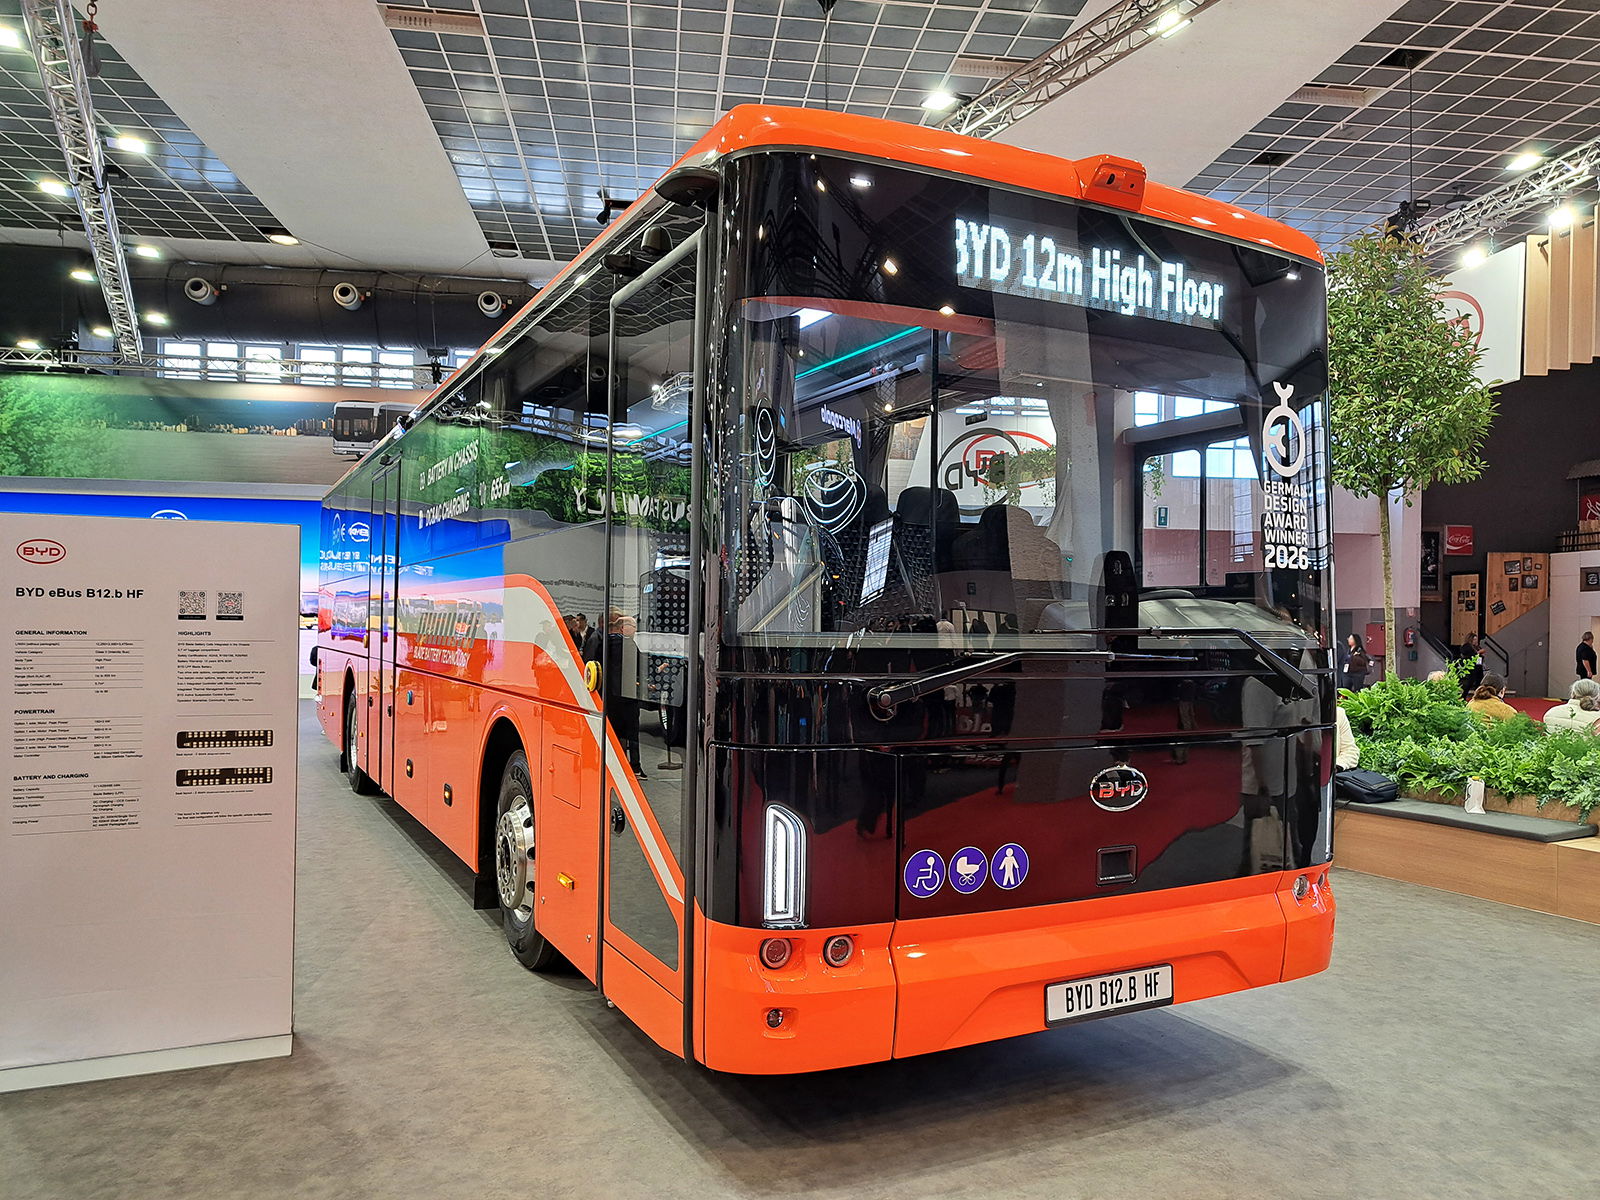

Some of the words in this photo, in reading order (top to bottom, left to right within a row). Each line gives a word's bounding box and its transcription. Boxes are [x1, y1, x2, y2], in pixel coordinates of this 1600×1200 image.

[955, 218, 1011, 282] BYD
[1021, 231, 1083, 296] 12m
[1091, 247, 1154, 316] High
[1160, 262, 1225, 321] Floor
[427, 457, 449, 487] BATTERY
[453, 439, 479, 472] CHASSIS
[1264, 481, 1308, 498] GERMAN
[441, 491, 471, 521] CHARGING
[1264, 496, 1308, 515] DESIGN
[1264, 512, 1308, 530] AWARD
[1264, 528, 1309, 546] WINNER
[23, 546, 61, 557] BYD
[1264, 545, 1309, 571] 2026
[15, 587, 45, 598] BYD
[48, 587, 82, 599] eBus
[86, 588, 123, 599] B12.b
[126, 589, 145, 599] HF
[1098, 781, 1143, 799] BYD
[1065, 983, 1093, 1014] BYD
[1100, 975, 1137, 1008] B12.B
[1145, 972, 1160, 998] HF
